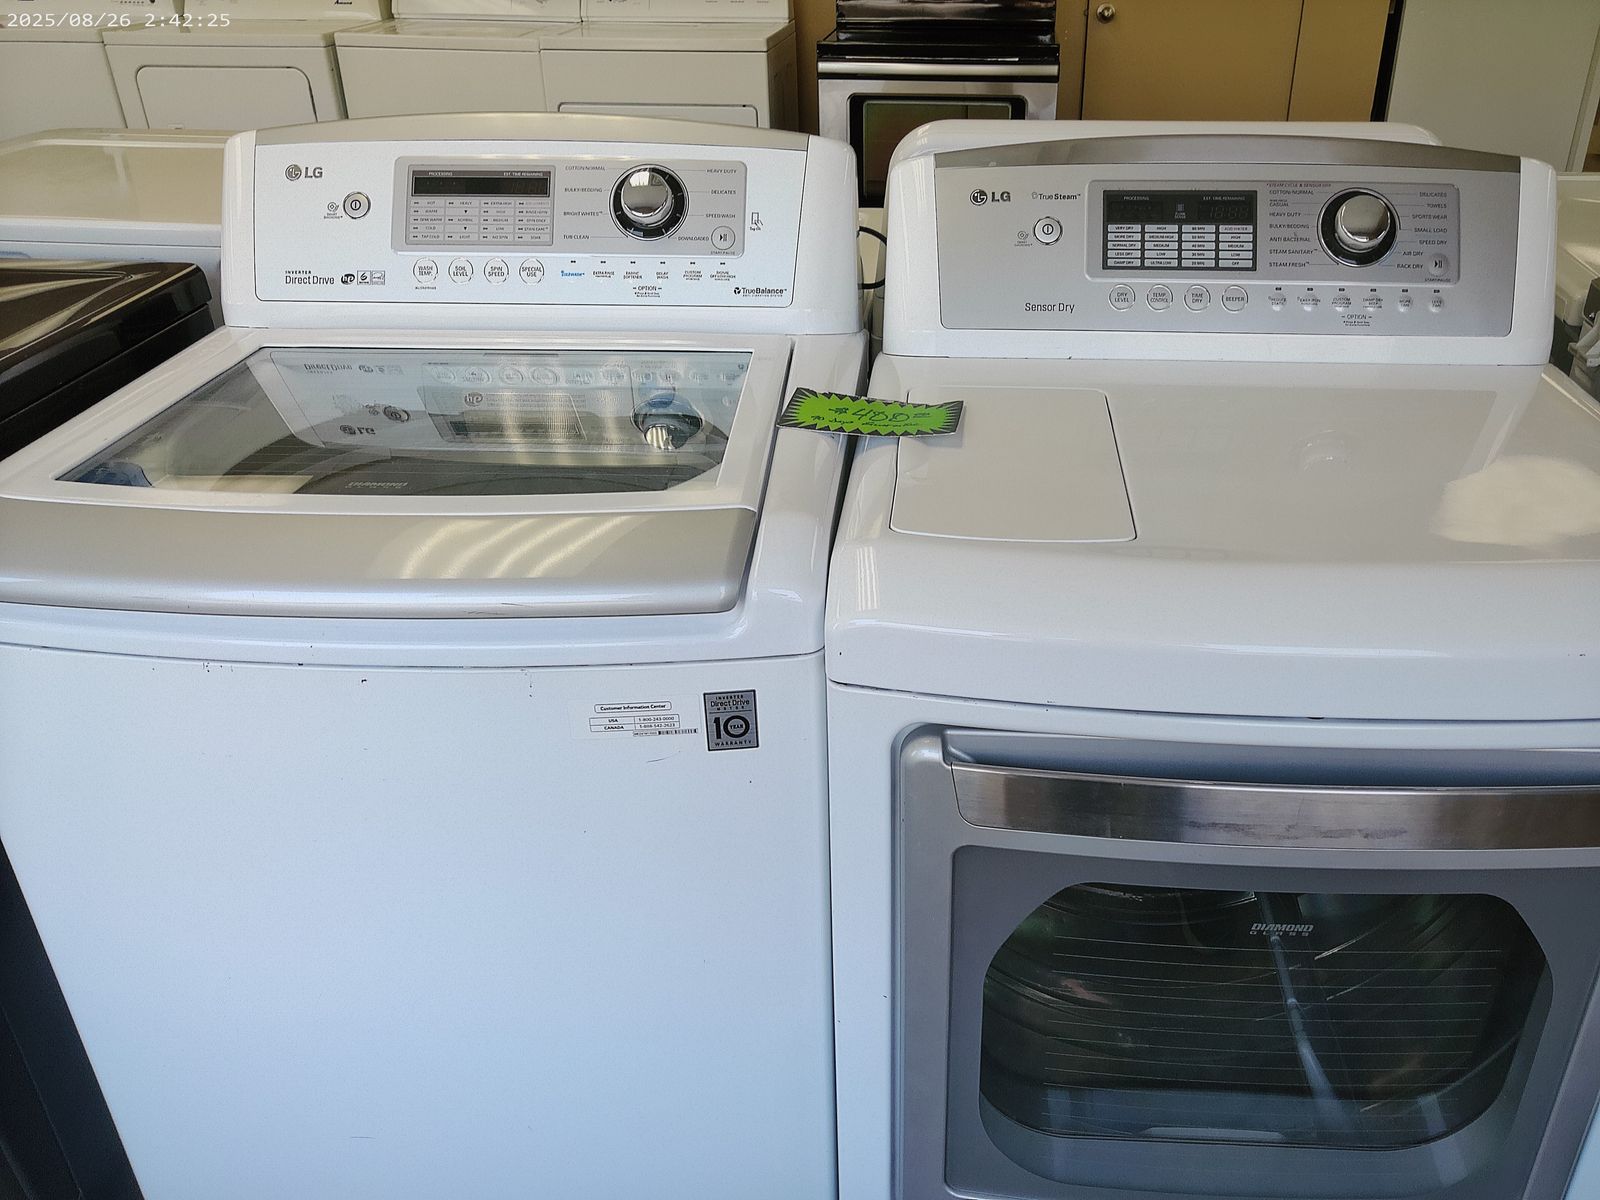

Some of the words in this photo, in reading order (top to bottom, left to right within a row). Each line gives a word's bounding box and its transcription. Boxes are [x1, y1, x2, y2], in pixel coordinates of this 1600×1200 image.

[304, 166, 323, 179] LG
[991, 191, 1011, 203] LG
[285, 275, 311, 285] Direct
[312, 275, 335, 285] Drive
[1024, 302, 1056, 312] Sensor
[1058, 302, 1075, 313] Dry
[713, 715, 750, 740] 10
[1250, 923, 1314, 932] DIAMOND
